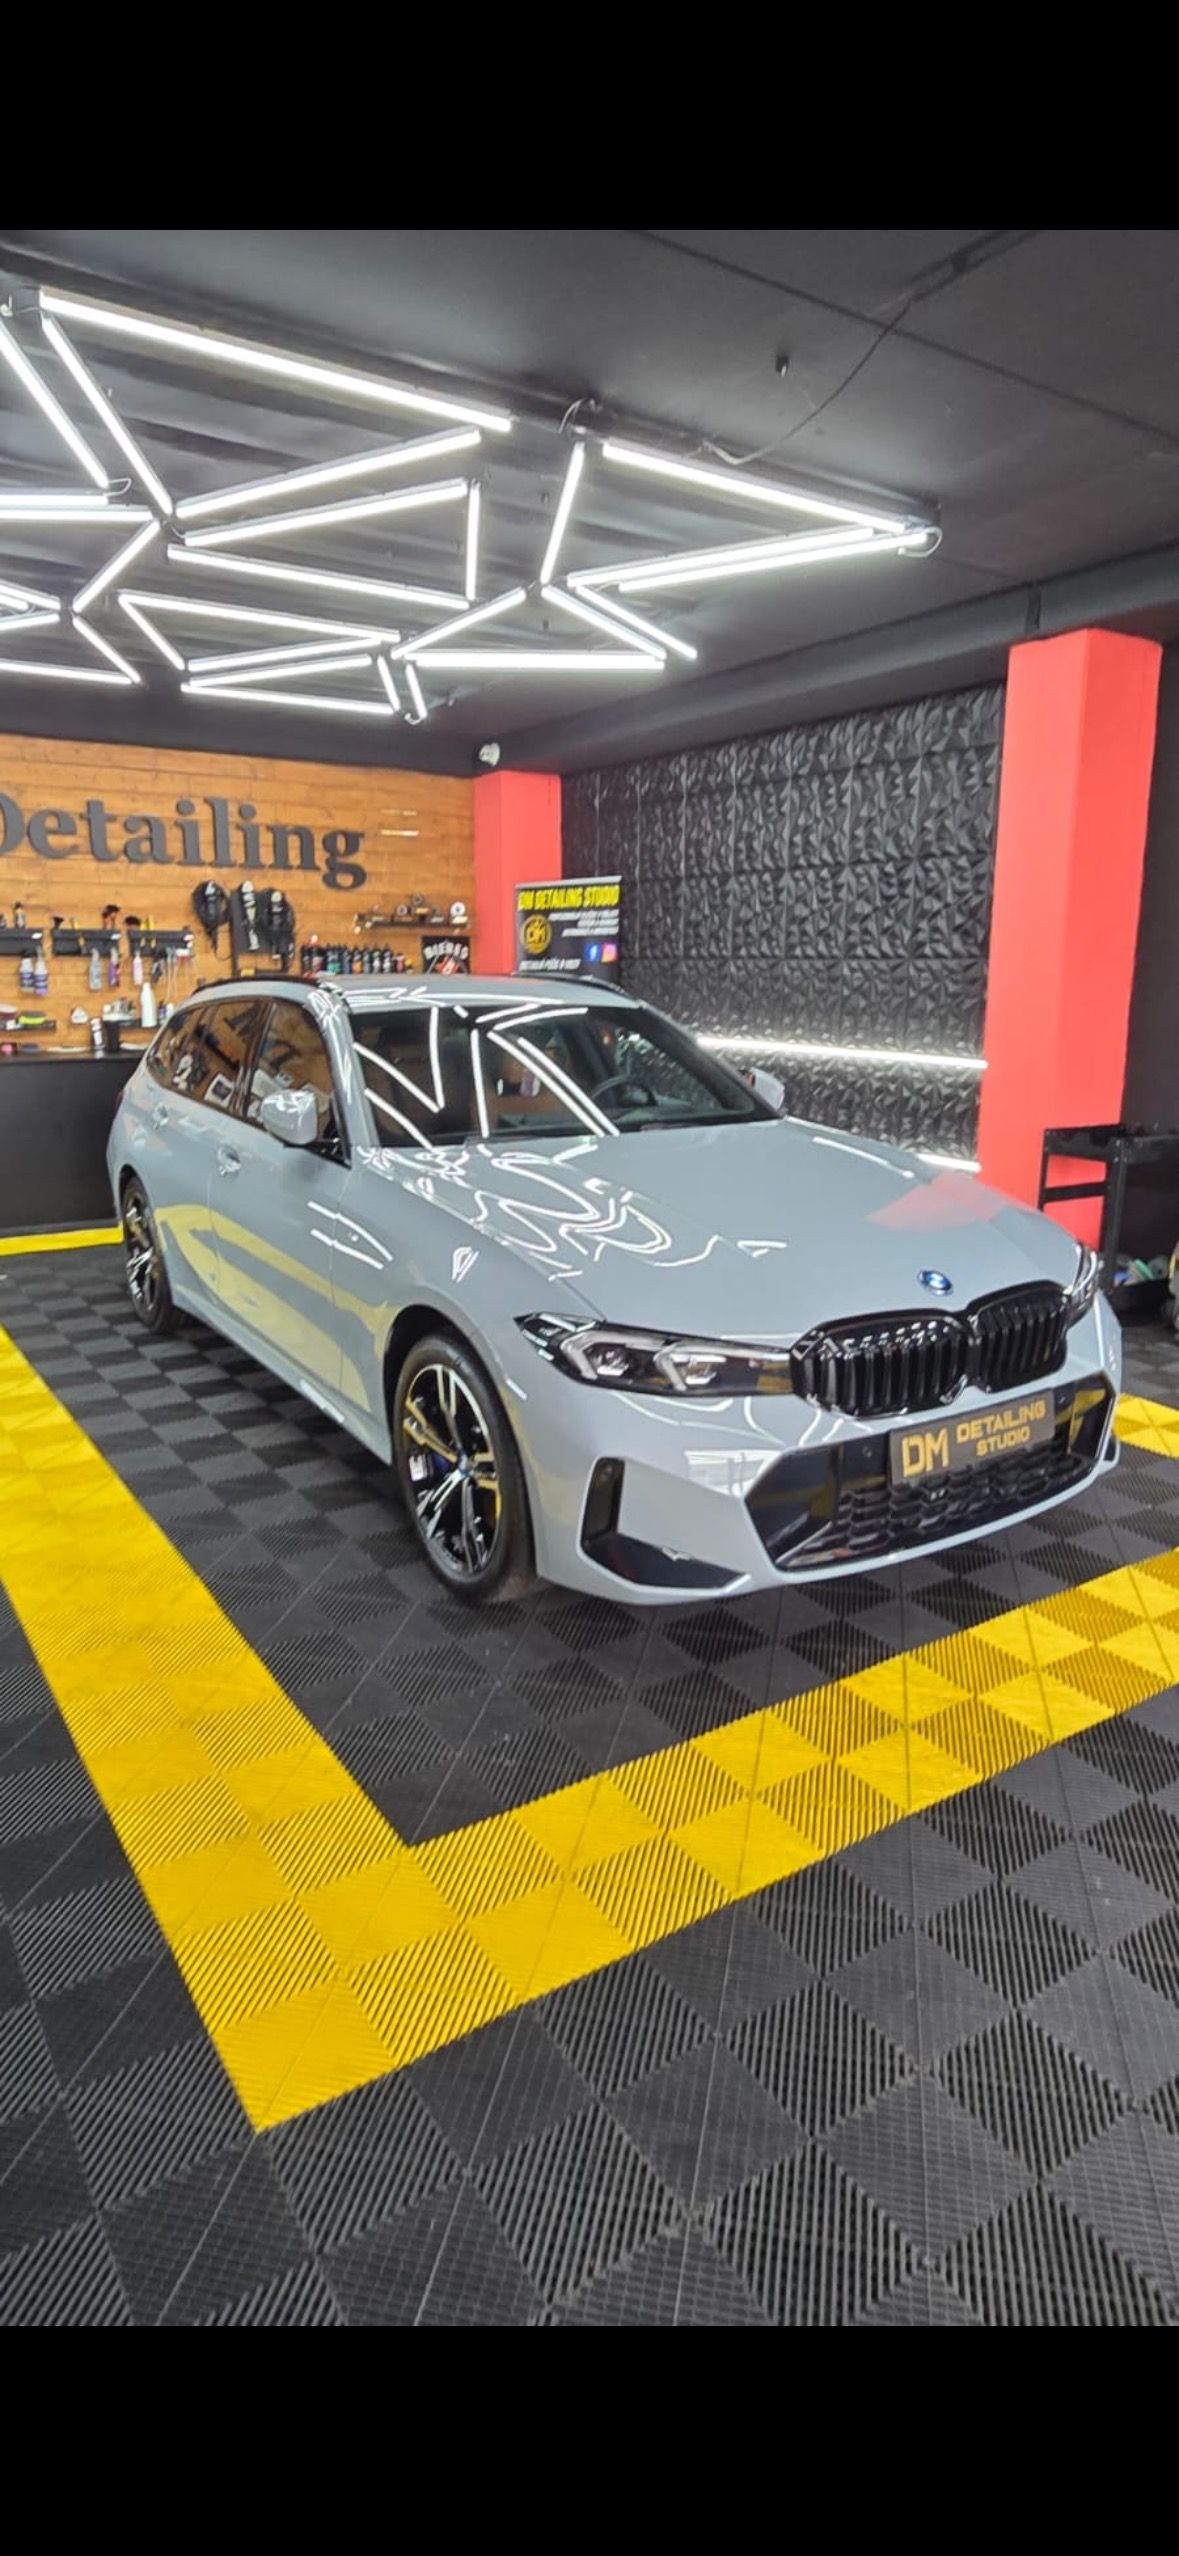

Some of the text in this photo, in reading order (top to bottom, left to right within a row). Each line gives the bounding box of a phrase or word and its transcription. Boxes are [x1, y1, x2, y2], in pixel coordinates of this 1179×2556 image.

[534, 886, 583, 910] DETAILING
[583, 884, 620, 908] STUDIO
[902, 1399, 1046, 1478] DM DETAILING
[976, 1426, 1030, 1456] STUDIO
